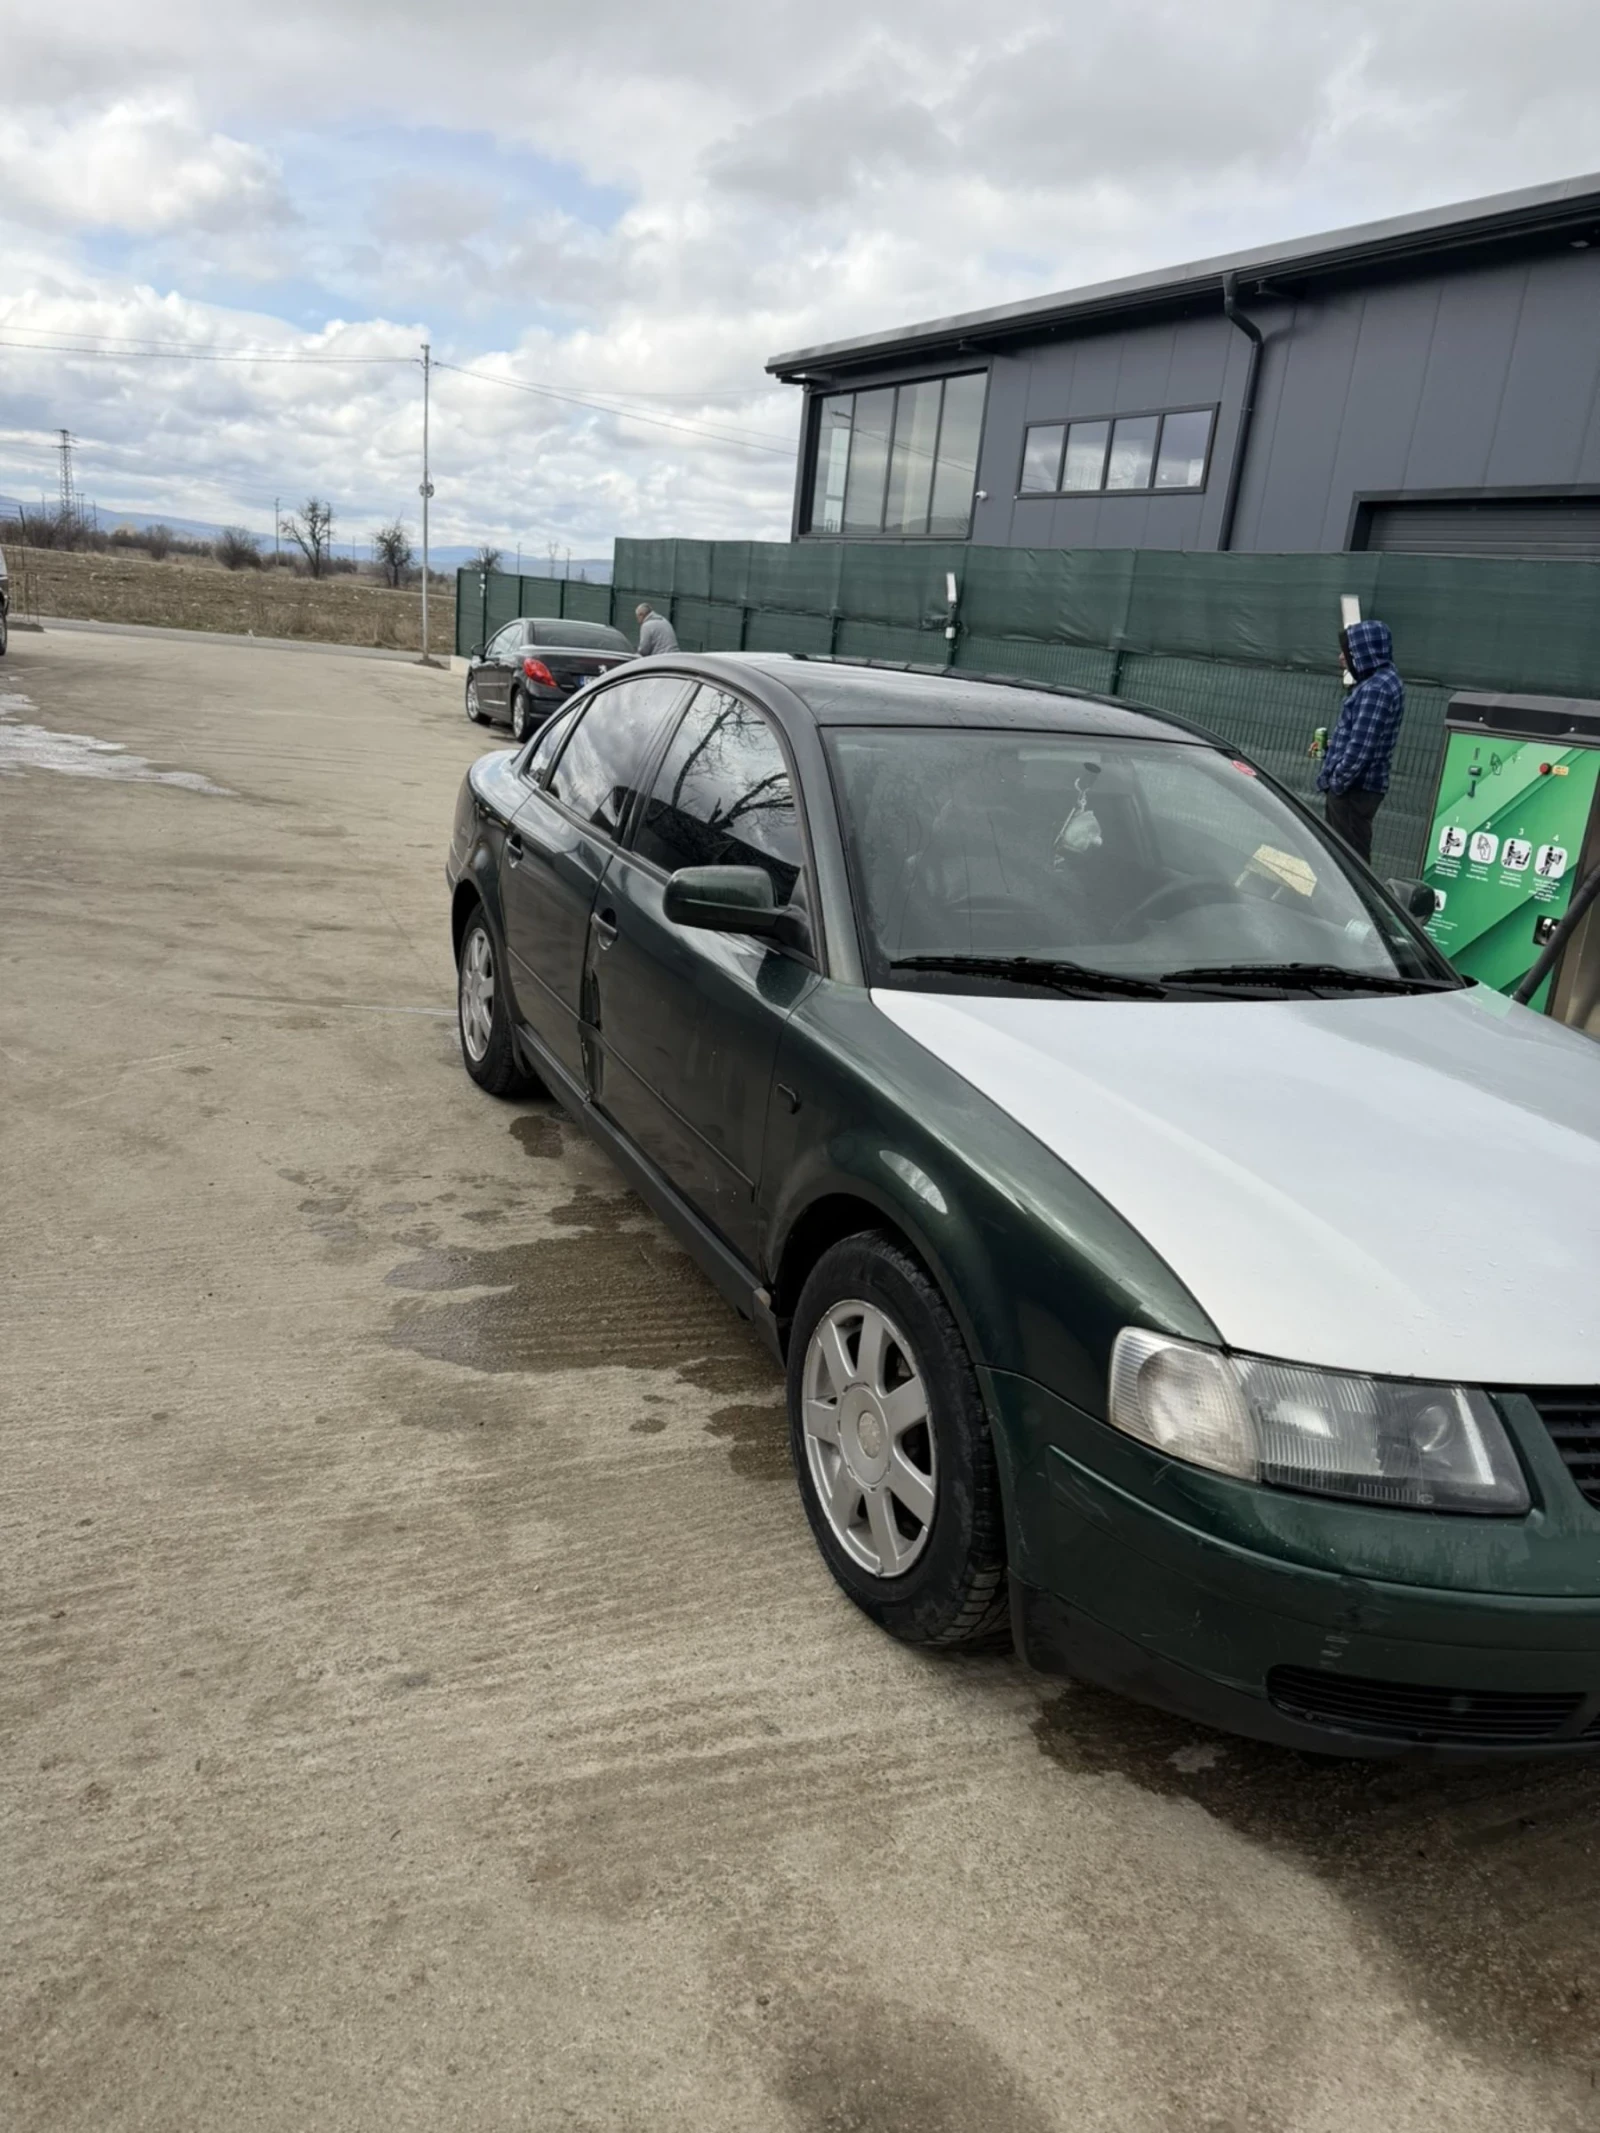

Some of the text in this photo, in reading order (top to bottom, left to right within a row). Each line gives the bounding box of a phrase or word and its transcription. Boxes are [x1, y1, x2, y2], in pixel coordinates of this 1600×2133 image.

[1485, 821, 1491, 829] 2
[1518, 827, 1524, 836] 3
[1552, 834, 1559, 842] 4
